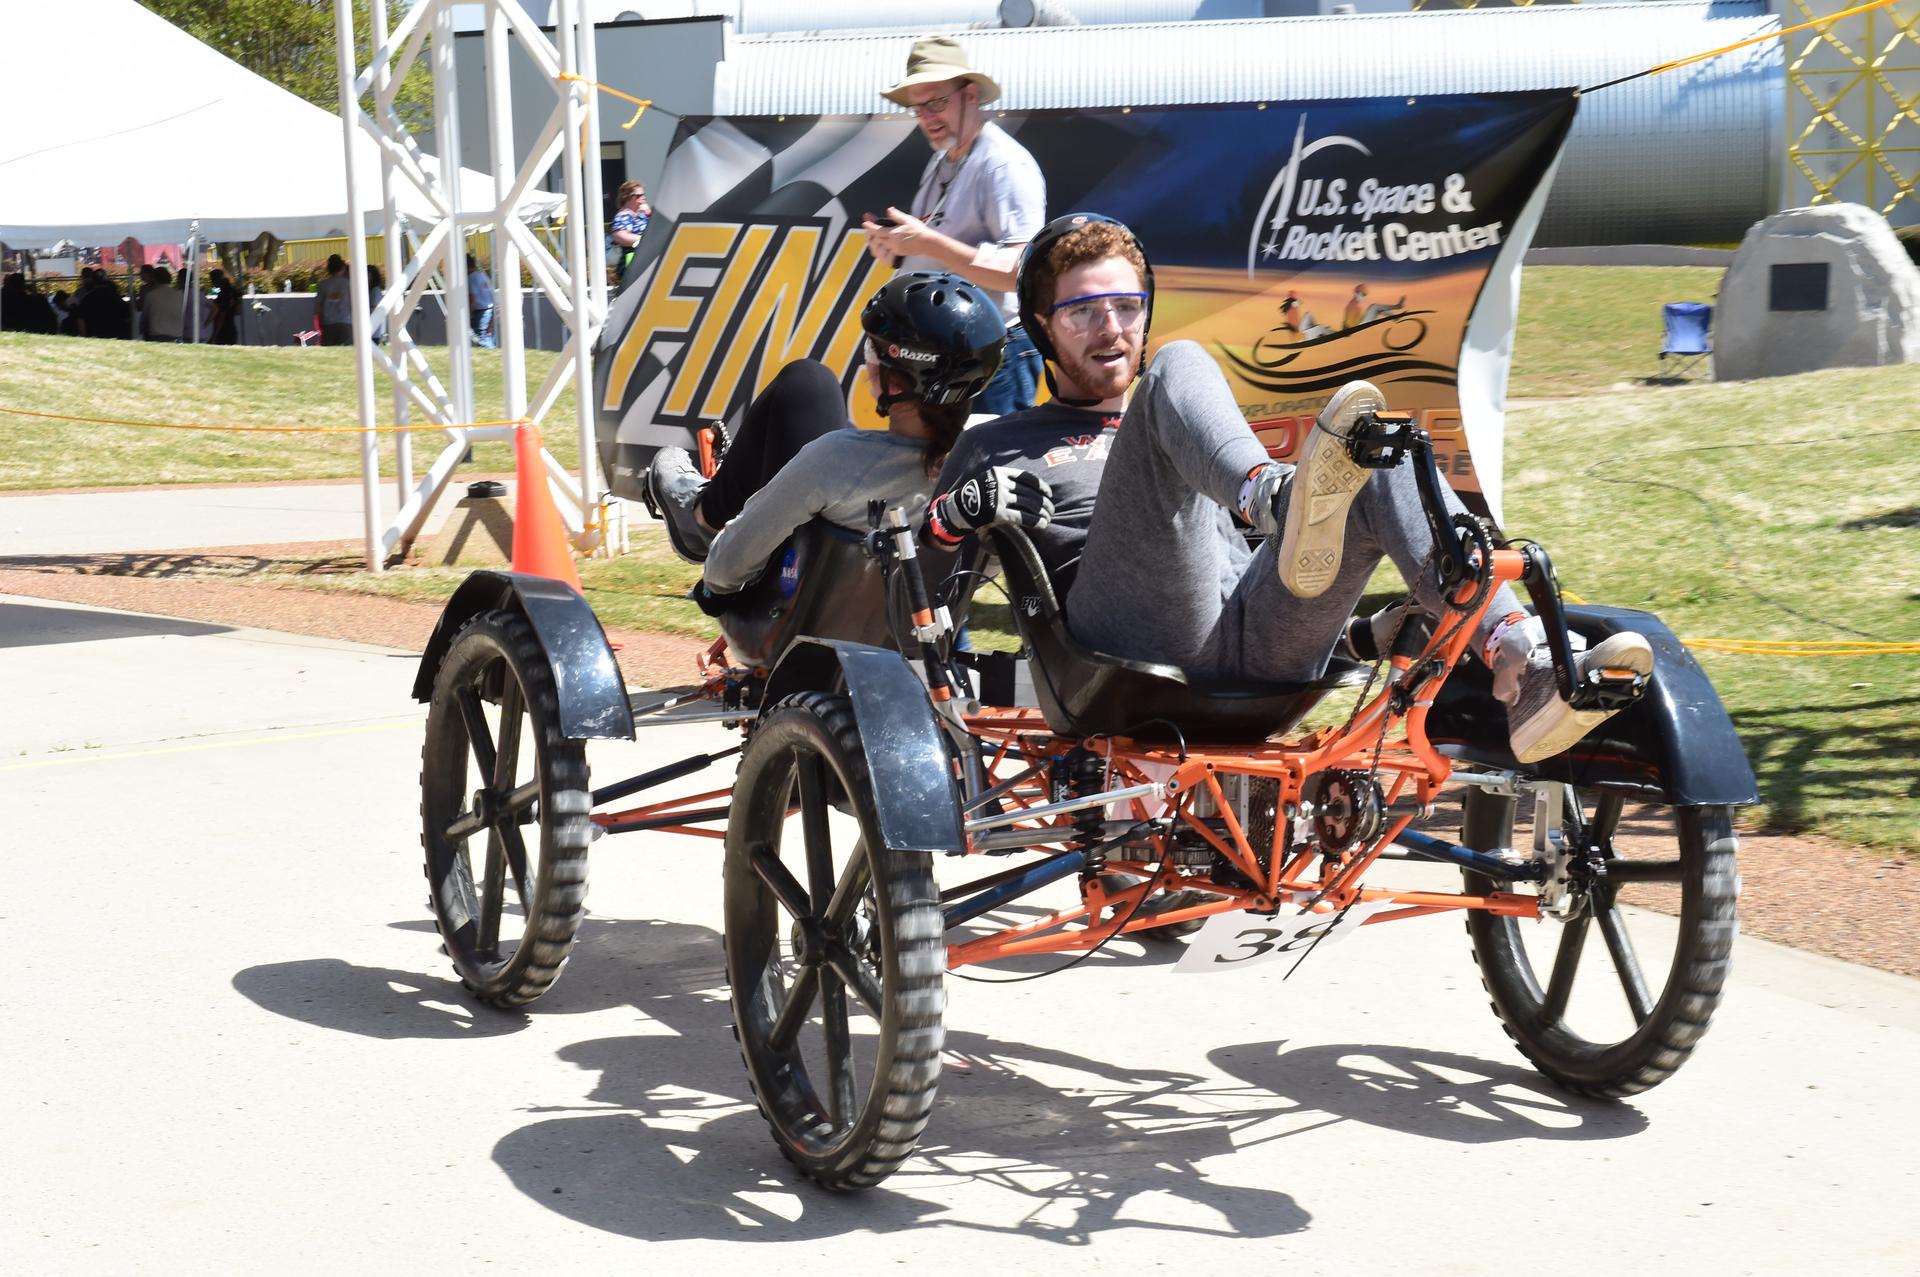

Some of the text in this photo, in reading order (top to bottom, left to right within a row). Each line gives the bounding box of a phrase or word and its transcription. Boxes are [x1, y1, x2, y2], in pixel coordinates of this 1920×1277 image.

[1296, 172, 1476, 222] U.S. Space &
[1277, 220, 1503, 262] Rocket Center
[603, 222, 894, 431] FINI
[1213, 918, 1344, 963] 38
